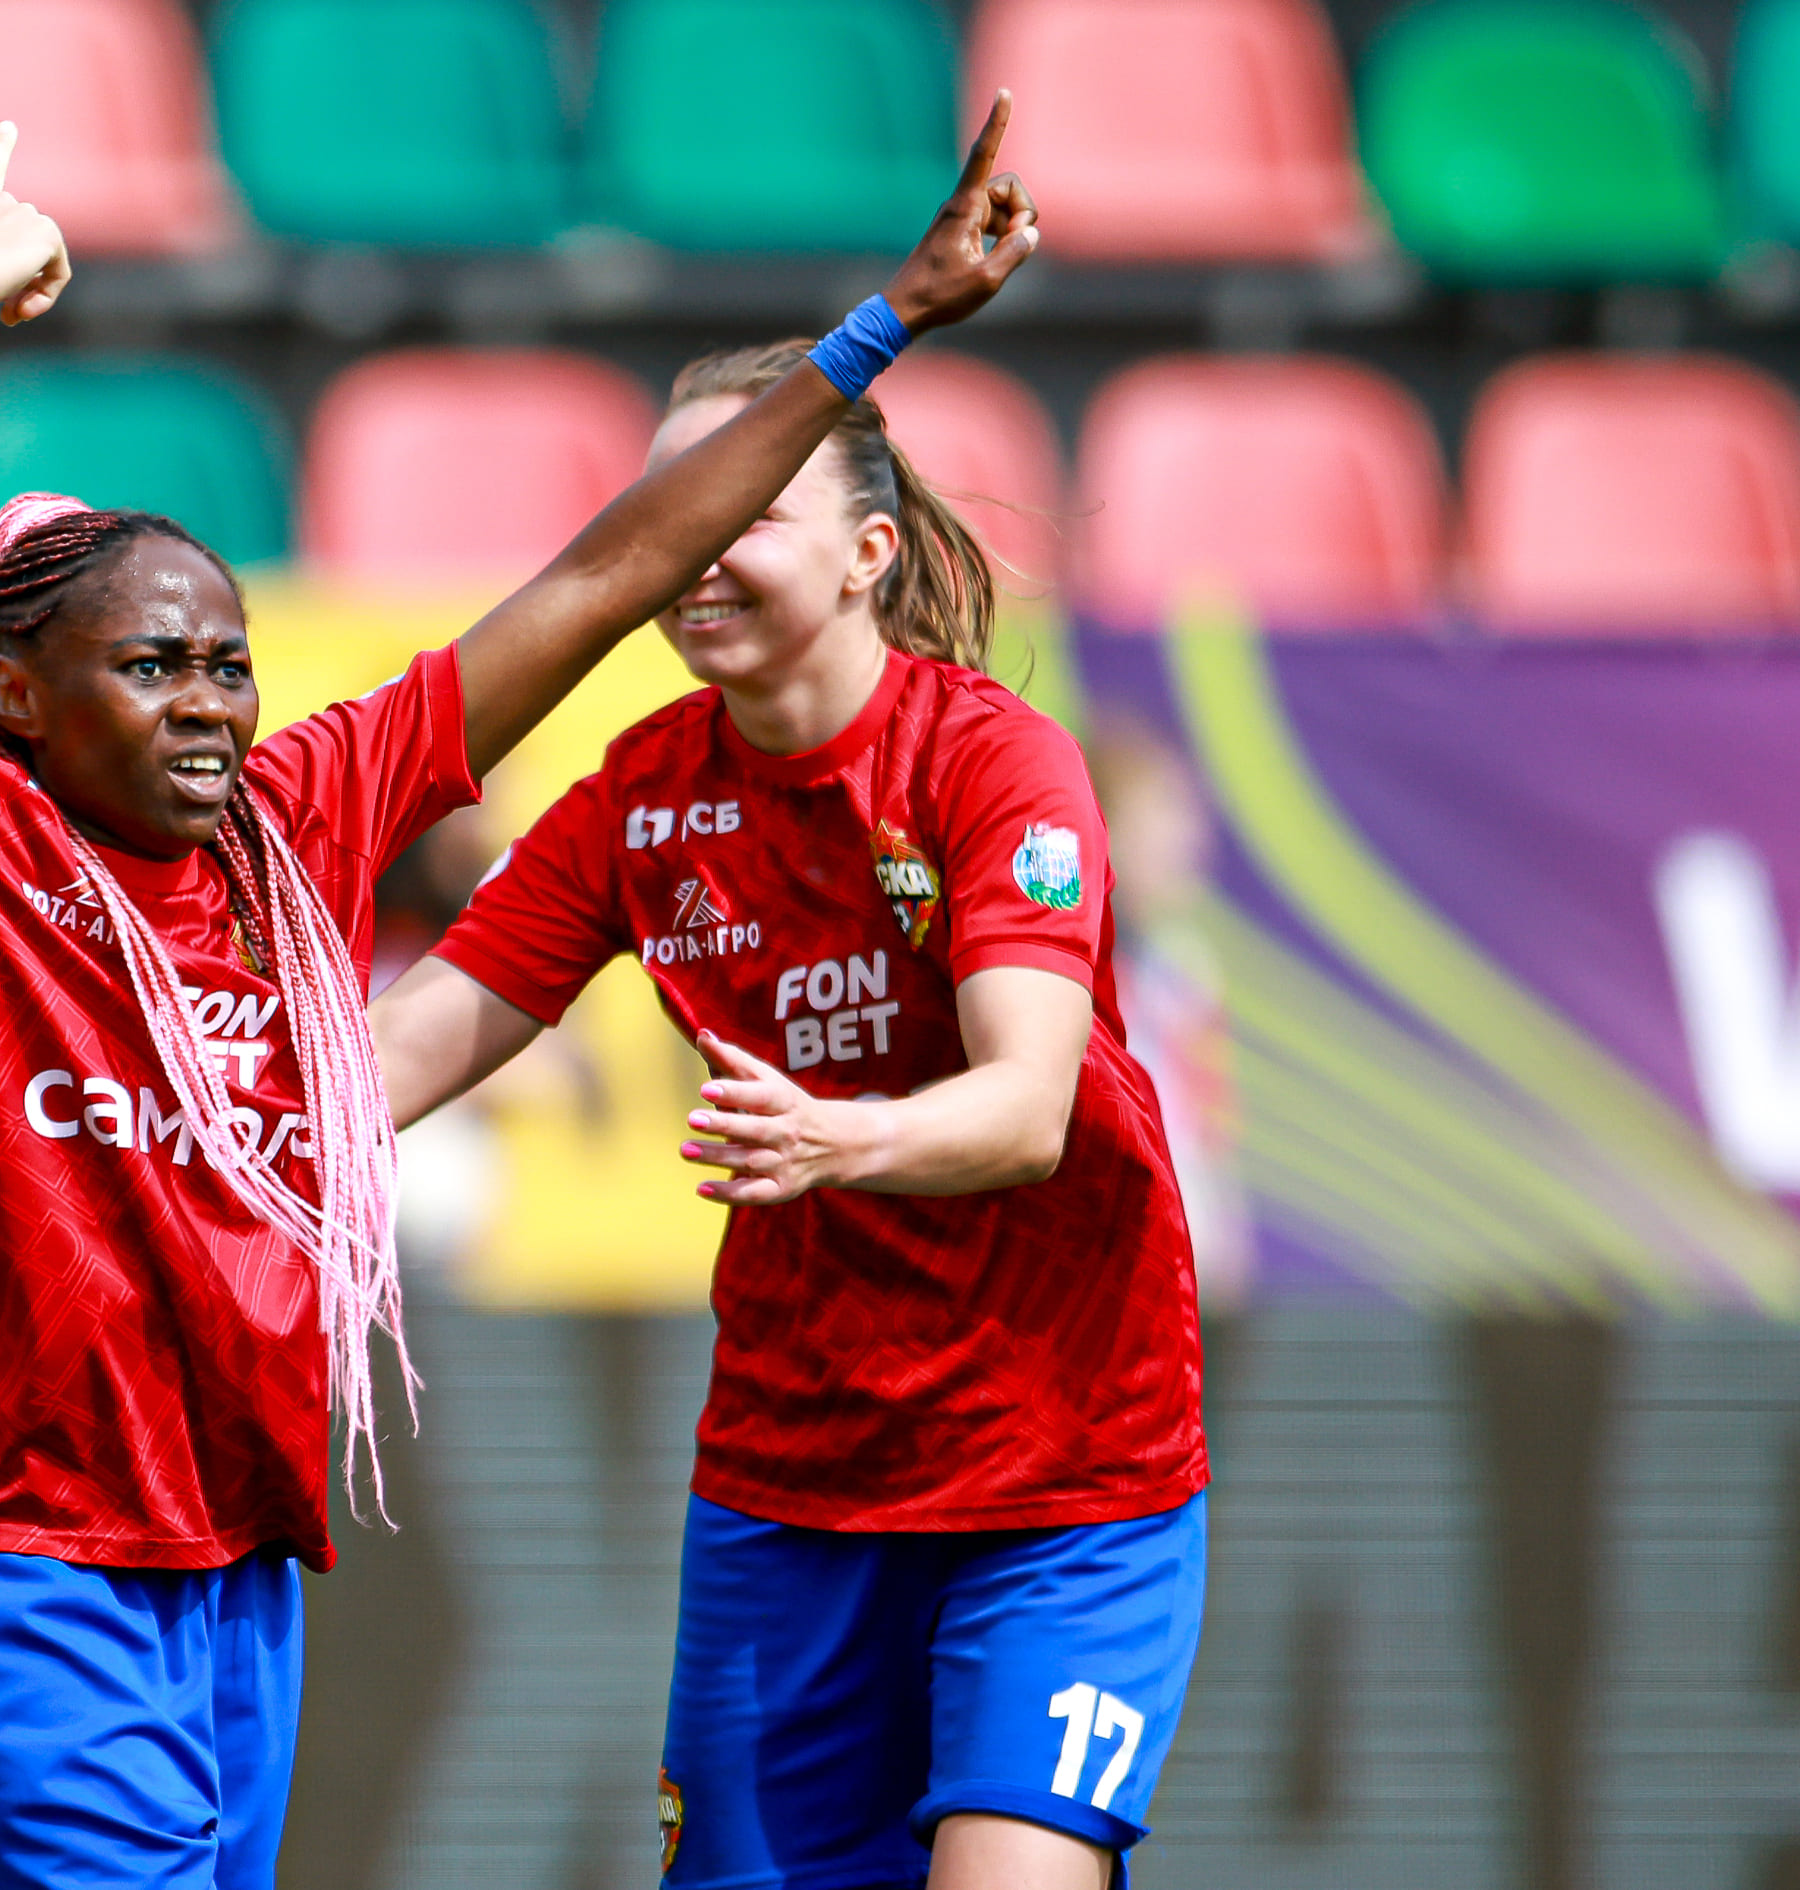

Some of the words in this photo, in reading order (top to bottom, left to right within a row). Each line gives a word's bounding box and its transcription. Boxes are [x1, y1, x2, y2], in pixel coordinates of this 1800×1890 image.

[774, 948, 889, 1021] FON
[785, 999, 900, 1072] BET
[1047, 1681, 1146, 1811] 17
